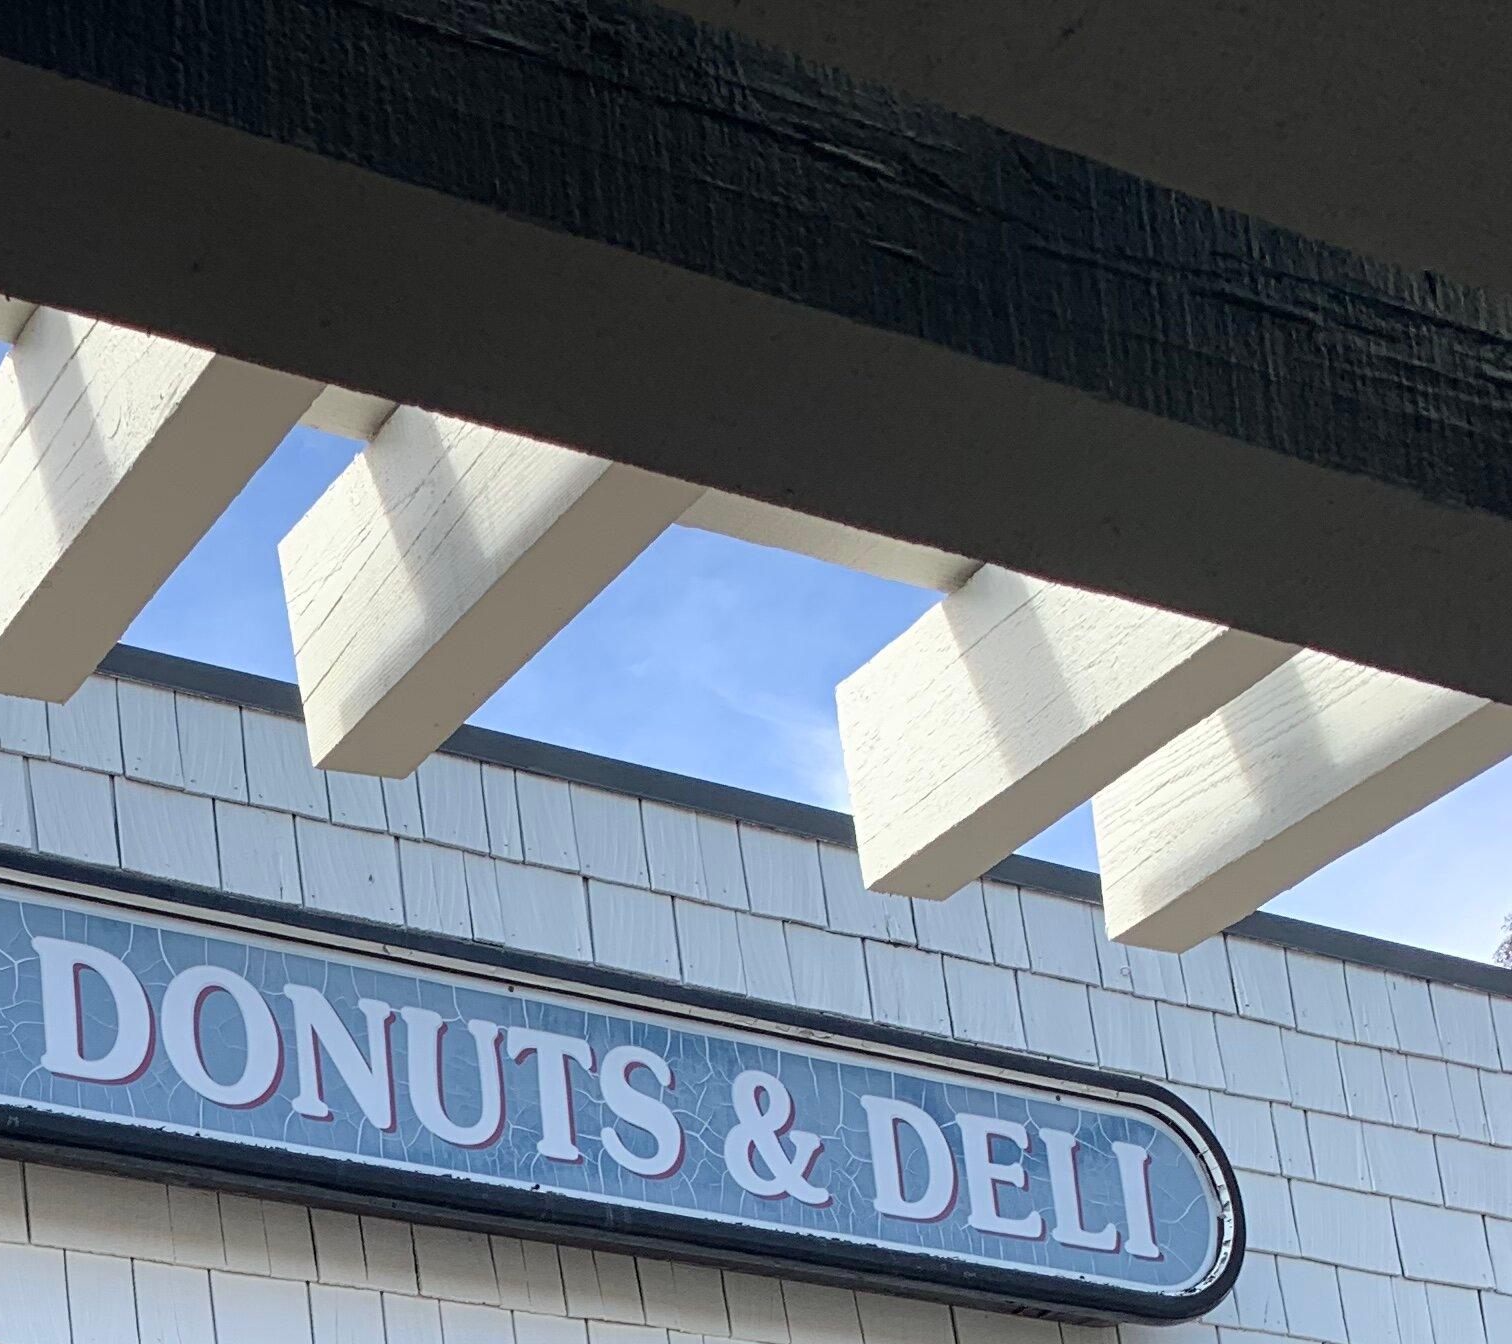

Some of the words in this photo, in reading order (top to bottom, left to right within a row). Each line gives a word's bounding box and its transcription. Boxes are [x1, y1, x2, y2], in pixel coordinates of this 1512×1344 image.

[32, 935, 685, 1179] DONUTS
[723, 1069, 833, 1209] &
[860, 1094, 1165, 1262] DELI
